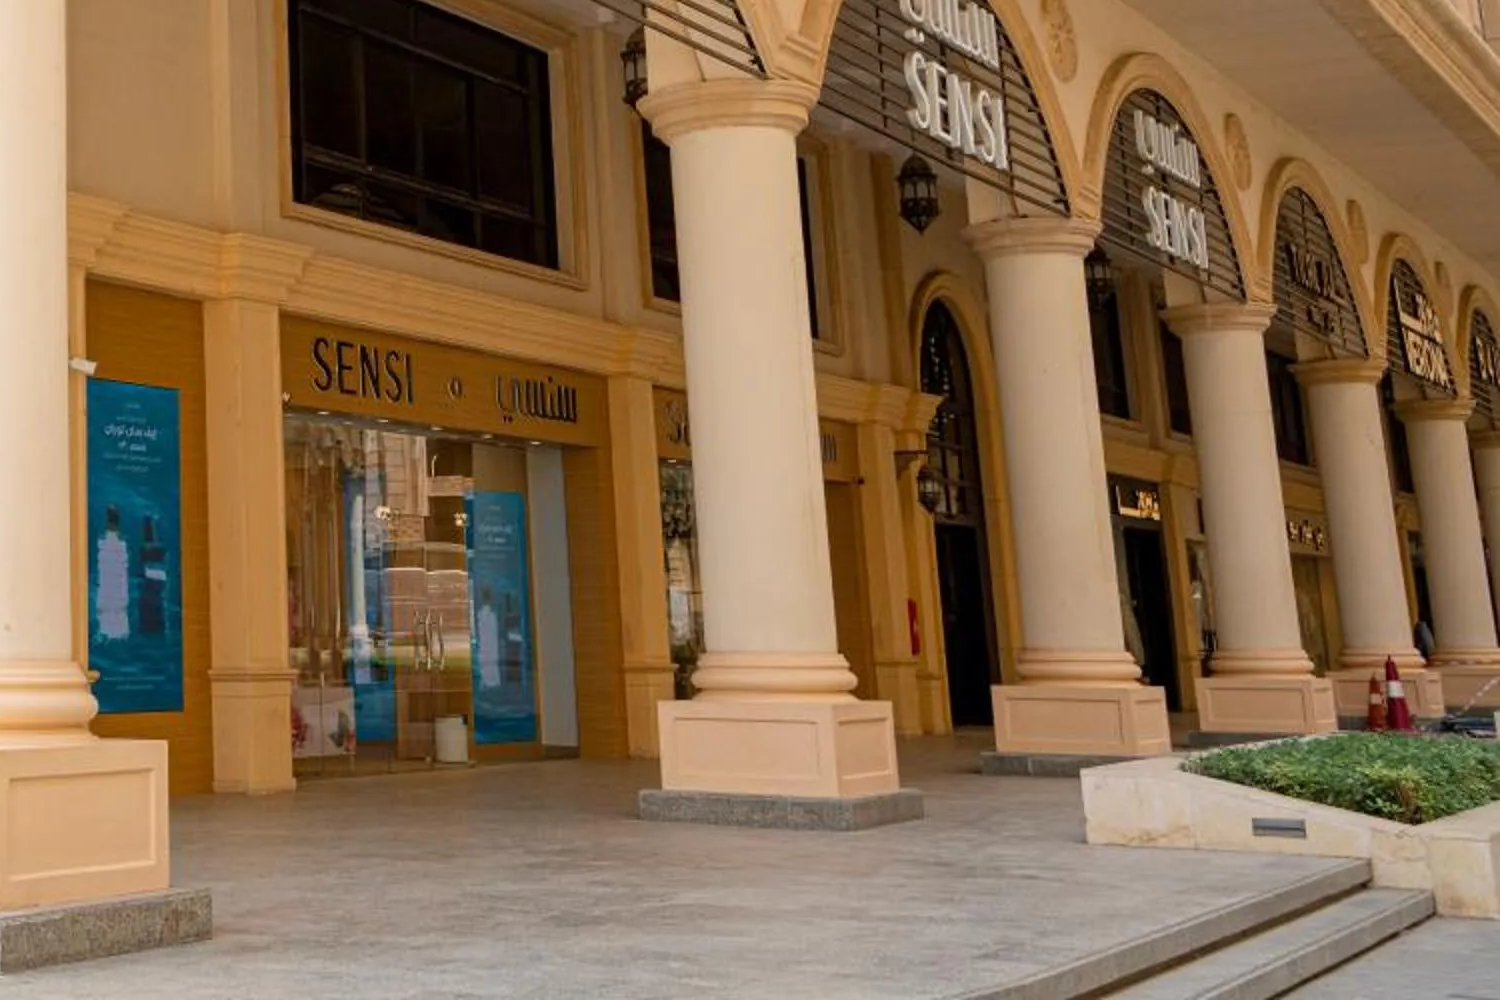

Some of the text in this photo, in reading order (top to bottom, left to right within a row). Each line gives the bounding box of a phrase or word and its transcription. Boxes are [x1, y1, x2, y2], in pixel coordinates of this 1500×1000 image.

[904, 50, 1009, 170] SENSI
[1142, 186, 1209, 269] SENSI
[312, 337, 415, 404] SENSI
[496, 375, 579, 425] سنسي
